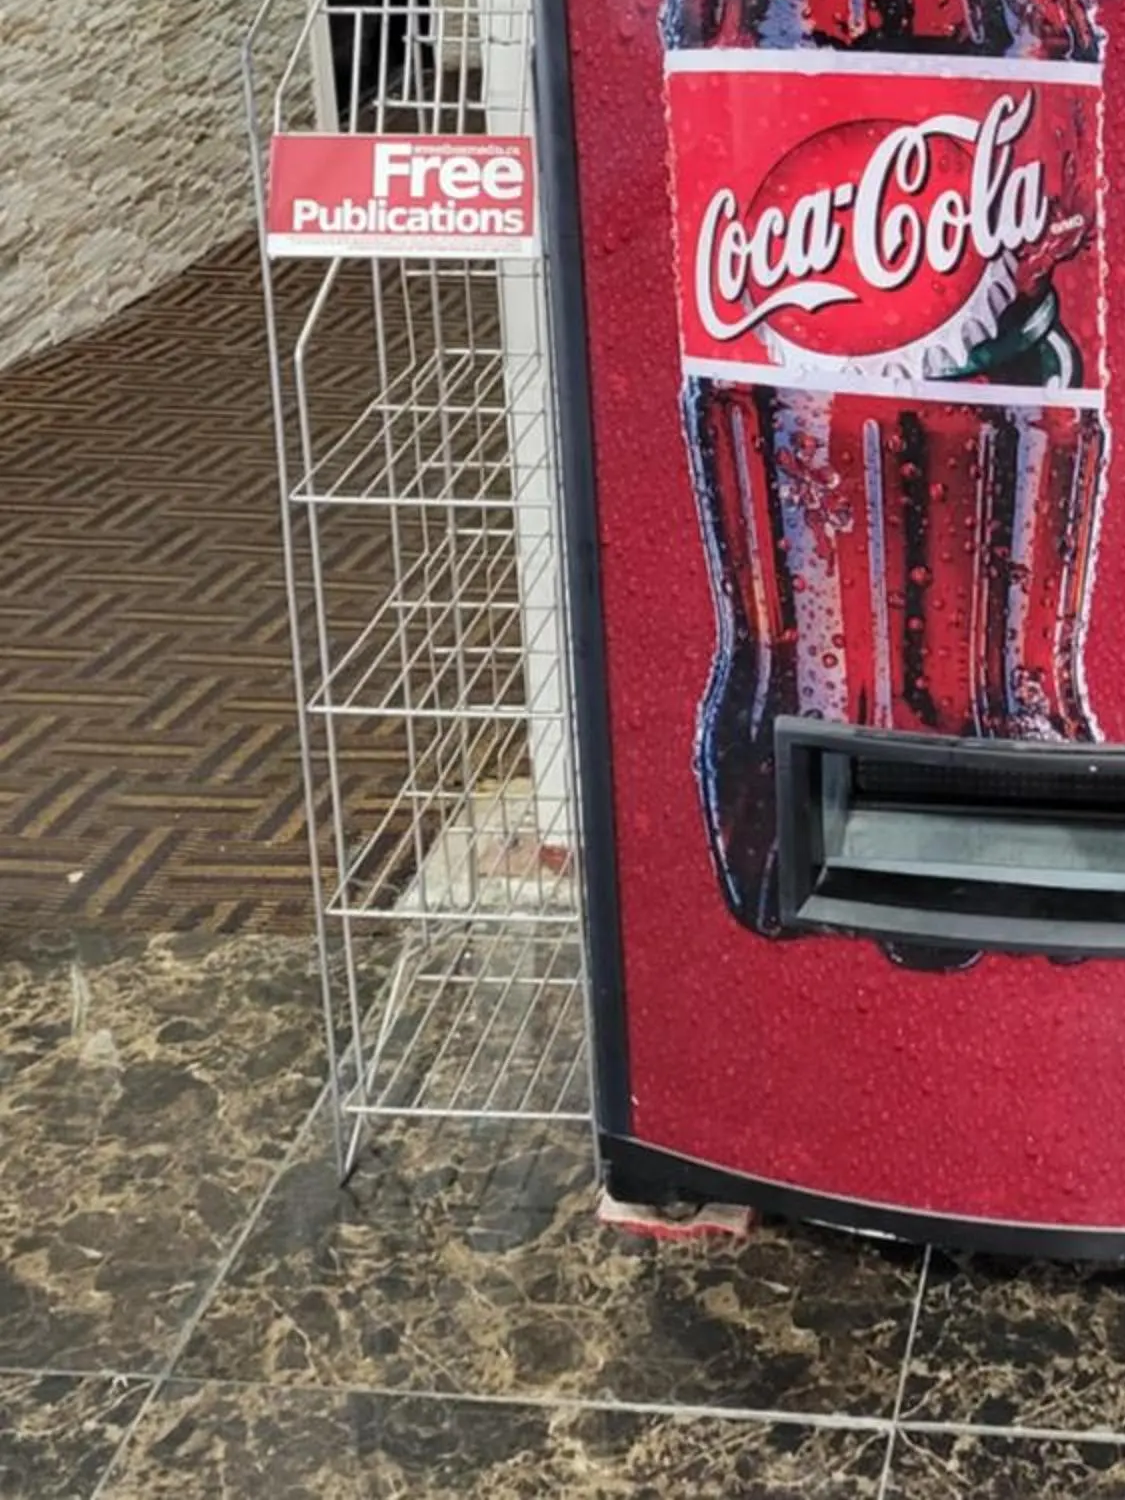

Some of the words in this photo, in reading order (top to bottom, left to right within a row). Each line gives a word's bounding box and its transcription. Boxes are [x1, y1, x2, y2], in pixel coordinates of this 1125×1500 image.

[372, 142, 525, 200] Free
[292, 198, 524, 234] Publications
[695, 88, 1049, 342] Coca-Cola
